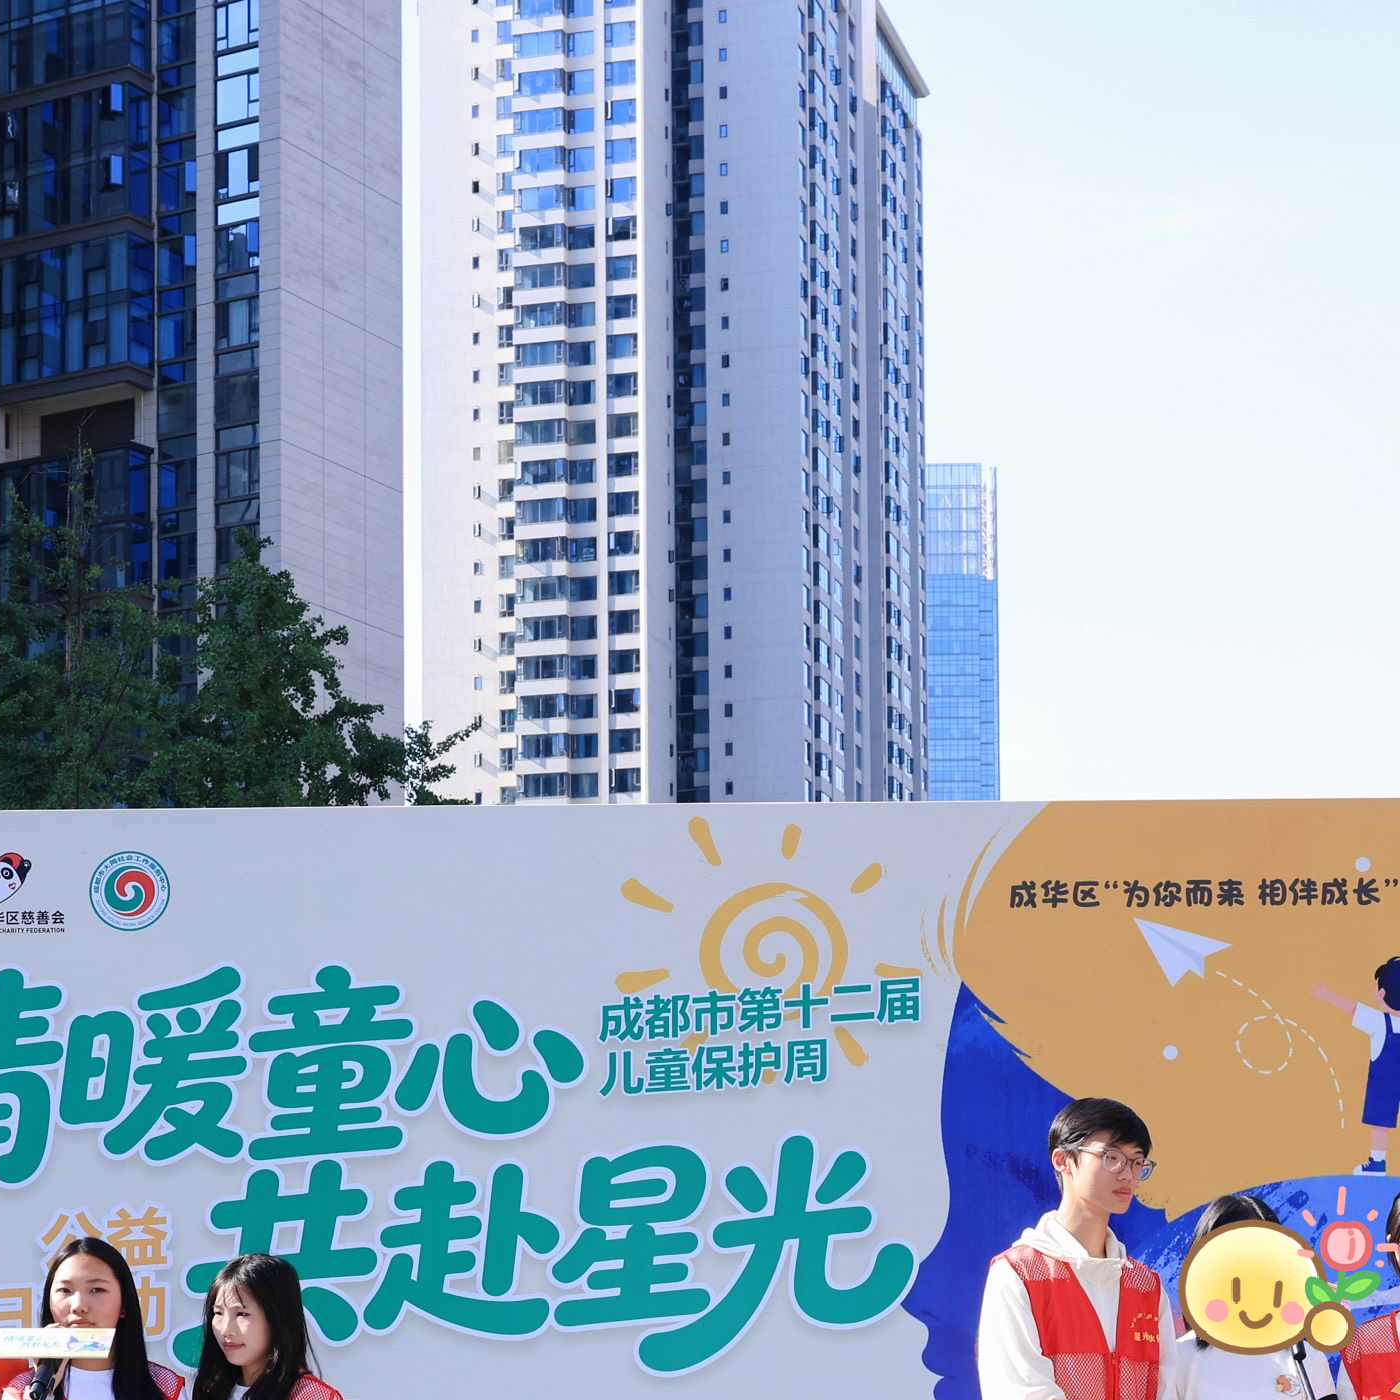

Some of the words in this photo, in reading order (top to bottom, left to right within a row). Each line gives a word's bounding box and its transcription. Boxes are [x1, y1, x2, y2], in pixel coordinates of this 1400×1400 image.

[599, 978, 920, 1043] 成都市第十二届
[599, 1038, 828, 1097] 儿童保护周
[172, 1136, 912, 1372] 共赴星光
